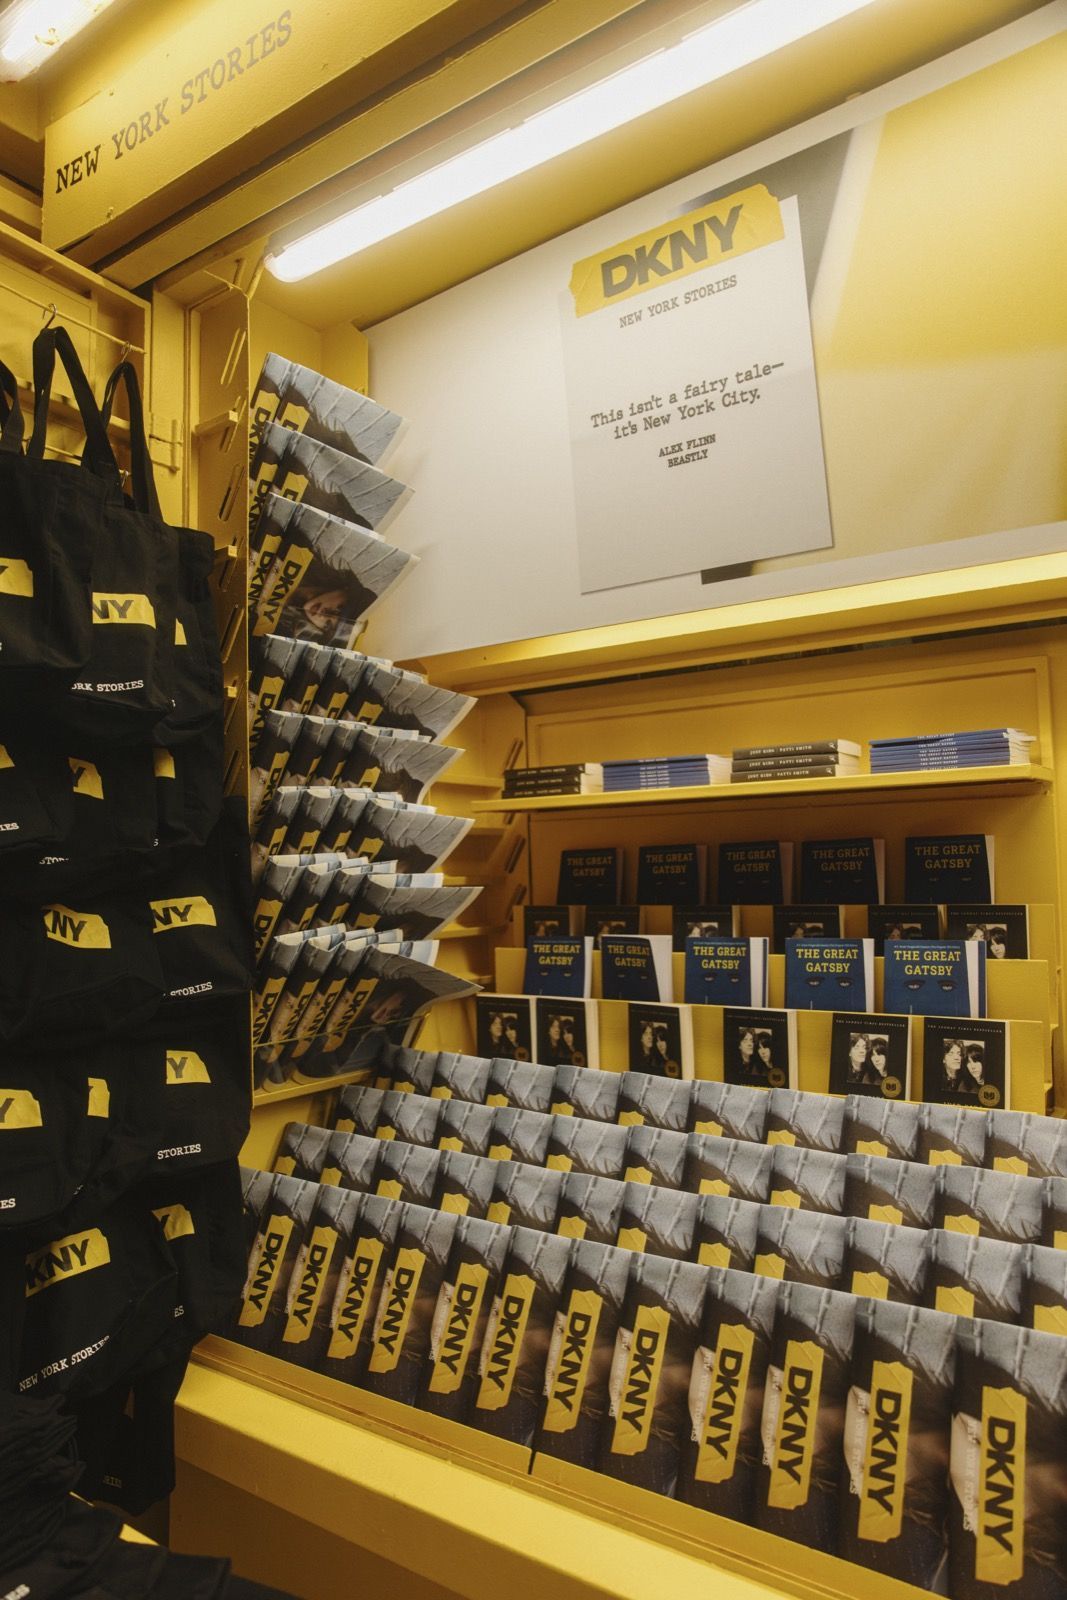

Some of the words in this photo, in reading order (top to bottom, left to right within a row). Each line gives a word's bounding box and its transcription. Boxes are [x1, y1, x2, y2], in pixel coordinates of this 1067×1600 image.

[55, 144, 102, 194] NEW
[111, 97, 172, 160] YORK
[179, 9, 293, 115] STORIES
[600, 203, 744, 299] DKNY
[619, 307, 643, 328] NEW
[648, 297, 680, 318] YORK
[683, 275, 738, 306] STORIES
[590, 407, 624, 428] This
[628, 394, 663, 416] isn't
[668, 393, 678, 404] a
[684, 372, 729, 401] fairy
[613, 421, 638, 440] it's
[643, 413, 672, 432] New
[677, 398, 716, 421] York
[721, 387, 761, 410] City.
[658, 441, 685, 458] ALEX
[685, 433, 717, 451] FLINN
[667, 449, 709, 468] BEASTLY
[262, 559, 302, 625] DKNY
[96, 680, 144, 692] STORIES
[726, 851, 745, 861] THE
[747, 849, 777, 861] GREAT
[812, 848, 834, 860] THE
[836, 847, 871, 859] GREAT
[914, 845, 940, 856] THE
[942, 844, 981, 856] GREAT
[733, 862, 770, 873] GATSBY
[821, 860, 864, 872] GATSBY
[925, 858, 973, 870] GATSBY
[533, 944, 551, 954] THE
[553, 944, 581, 954] GREAT
[538, 956, 574, 966] GATSBY
[607, 944, 625, 955] THE
[626, 944, 650, 957] GREAT
[693, 946, 714, 957] THE
[717, 946, 747, 958] GREAT
[796, 948, 820, 959] THE
[822, 948, 859, 960] GREAT
[894, 950, 920, 961] THE
[923, 950, 961, 962] GREAT
[614, 956, 647, 968] GATSBY
[702, 958, 740, 970] GATSBY
[806, 962, 850, 973] GATSBY
[904, 964, 953, 976] GATSBY
[157, 1143, 202, 1160] STORIES
[248, 1232, 284, 1312] DKNY
[292, 1244, 328, 1328] DKNY
[337, 1256, 374, 1342] DKNY
[378, 1267, 415, 1356] DKNY
[440, 1282, 479, 1376] DKNY
[486, 1295, 526, 1392] DKNY
[553, 1311, 593, 1413] DKNY
[19, 1373, 39, 1392] NEW
[41, 1358, 69, 1379] YORK
[621, 1327, 660, 1435] DKNY
[705, 1347, 743, 1461] DKNY
[777, 1365, 813, 1486] DKNY
[867, 1387, 903, 1517] DKNY
[983, 1415, 1016, 1557] DKNY
